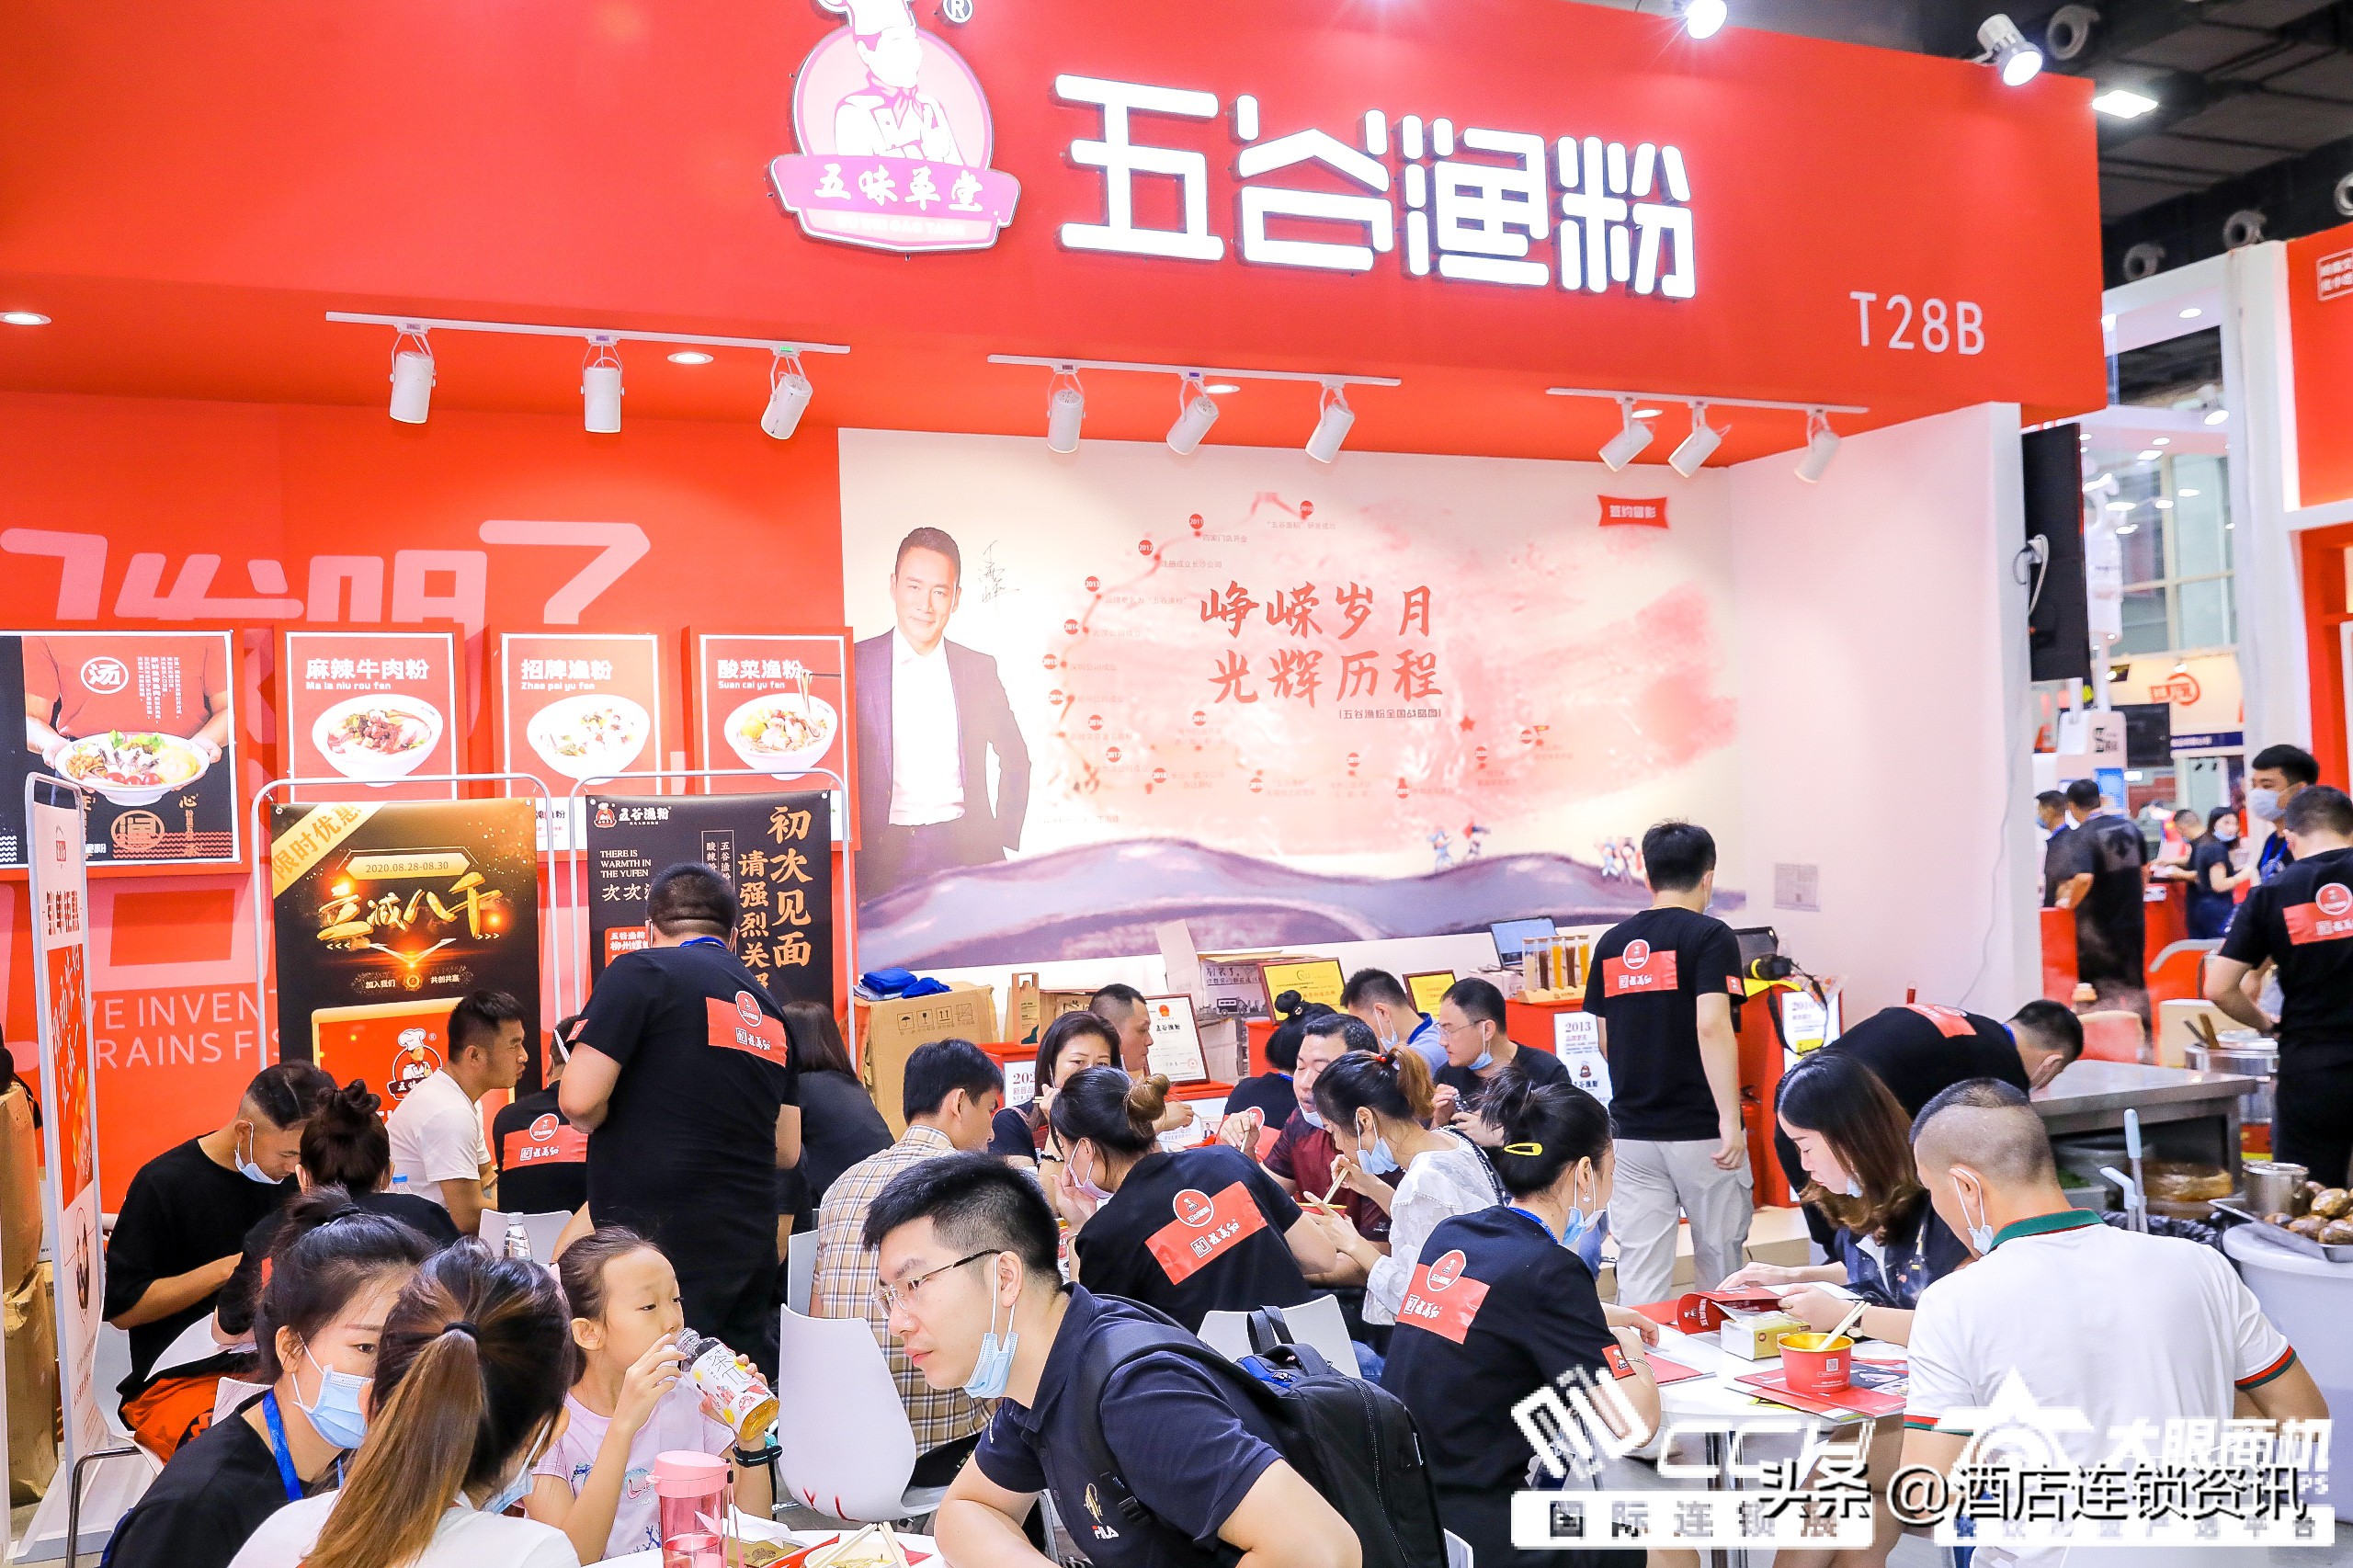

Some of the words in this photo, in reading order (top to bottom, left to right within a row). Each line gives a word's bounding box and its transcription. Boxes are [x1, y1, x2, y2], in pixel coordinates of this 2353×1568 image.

[813, 164, 984, 211] 五味草堂
[1054, 74, 1697, 299] 五谷渔粉
[1849, 291, 1985, 357] T28B
[1189, 517, 1203, 527] 2011
[1200, 580, 1432, 640] 峥嵘岁月
[305, 658, 429, 680] 麻辣牛肉粉
[521, 659, 613, 681] 招牌渔粉
[717, 659, 803, 680] 酸菜渔粉
[1208, 648, 1443, 709] 光辉历程
[306, 681, 322, 690] Ma
[335, 681, 351, 690] niu
[718, 681, 741, 689] Suan
[619, 807, 669, 822] 五谷渔粉
[272, 802, 362, 881] 限时优惠
[600, 849, 629, 858] THERE
[630, 849, 638, 858] IS
[365, 861, 449, 874] 2020.08.28-08.30
[600, 859, 642, 869] WARMTH
[642, 858, 652, 867] IN
[600, 869, 618, 879] THE
[620, 869, 649, 878] YUFEN
[602, 883, 650, 902] 次次
[767, 805, 813, 968] 初次见面
[317, 872, 503, 941] 立减八千
[365, 979, 396, 990] 加入我们
[1565, 1021, 1591, 1033] 2013
[1091, 1525, 1120, 1540] FILA
